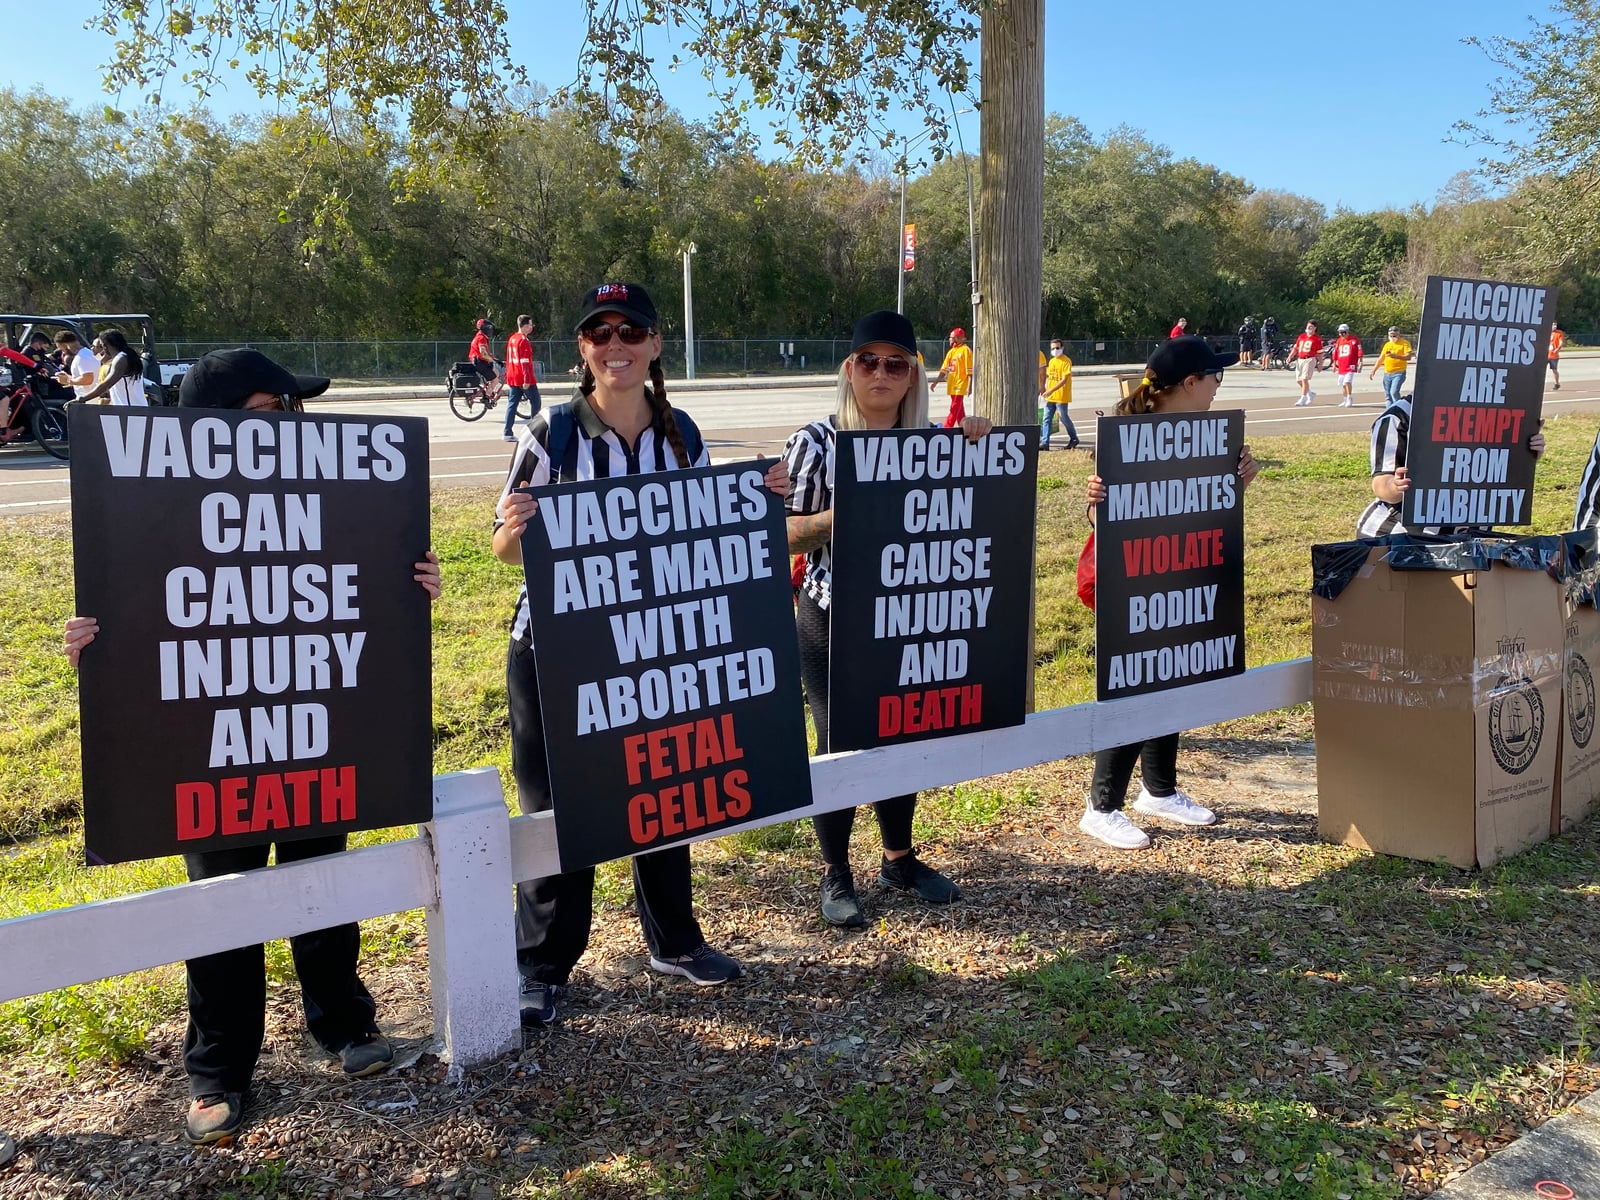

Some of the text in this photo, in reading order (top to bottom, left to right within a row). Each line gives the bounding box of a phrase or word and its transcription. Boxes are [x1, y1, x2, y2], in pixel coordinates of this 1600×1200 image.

[1440, 280, 1547, 326] VACCINE
[1299, 340, 1312, 353] 19
[1339, 344, 1350, 357] 19
[1436, 323, 1537, 366] MAKERS
[1459, 366, 1508, 404] ARE
[99, 414, 406, 482] VACCINES
[1118, 418, 1229, 463] VACCINE
[1431, 406, 1525, 444] EXEMPT
[852, 431, 1026, 482] VACCINES
[1441, 447, 1510, 484] FROM
[200, 491, 322, 554] CAN
[537, 470, 768, 551] VACCINES
[903, 487, 974, 534] CAN
[1108, 473, 1236, 522] MANDATES
[1413, 488, 1526, 524] LIABILITY
[553, 529, 773, 615] ARE MADE
[880, 537, 992, 588] CAUSE
[1123, 528, 1223, 577] VIOLATE
[165, 563, 360, 628] CAUSE
[874, 586, 994, 639] INJURY
[1129, 583, 1218, 634] BODILY
[609, 595, 733, 665] WITH
[159, 631, 367, 701] INJURY
[898, 638, 968, 686] AND
[1108, 634, 1237, 691] AUTONOMY
[577, 646, 776, 736] ABORTED
[878, 684, 982, 737] DEATH
[208, 702, 329, 768] AND
[622, 713, 745, 787] FETAL
[175, 765, 357, 841] DEATH
[625, 767, 751, 844] CELLS
